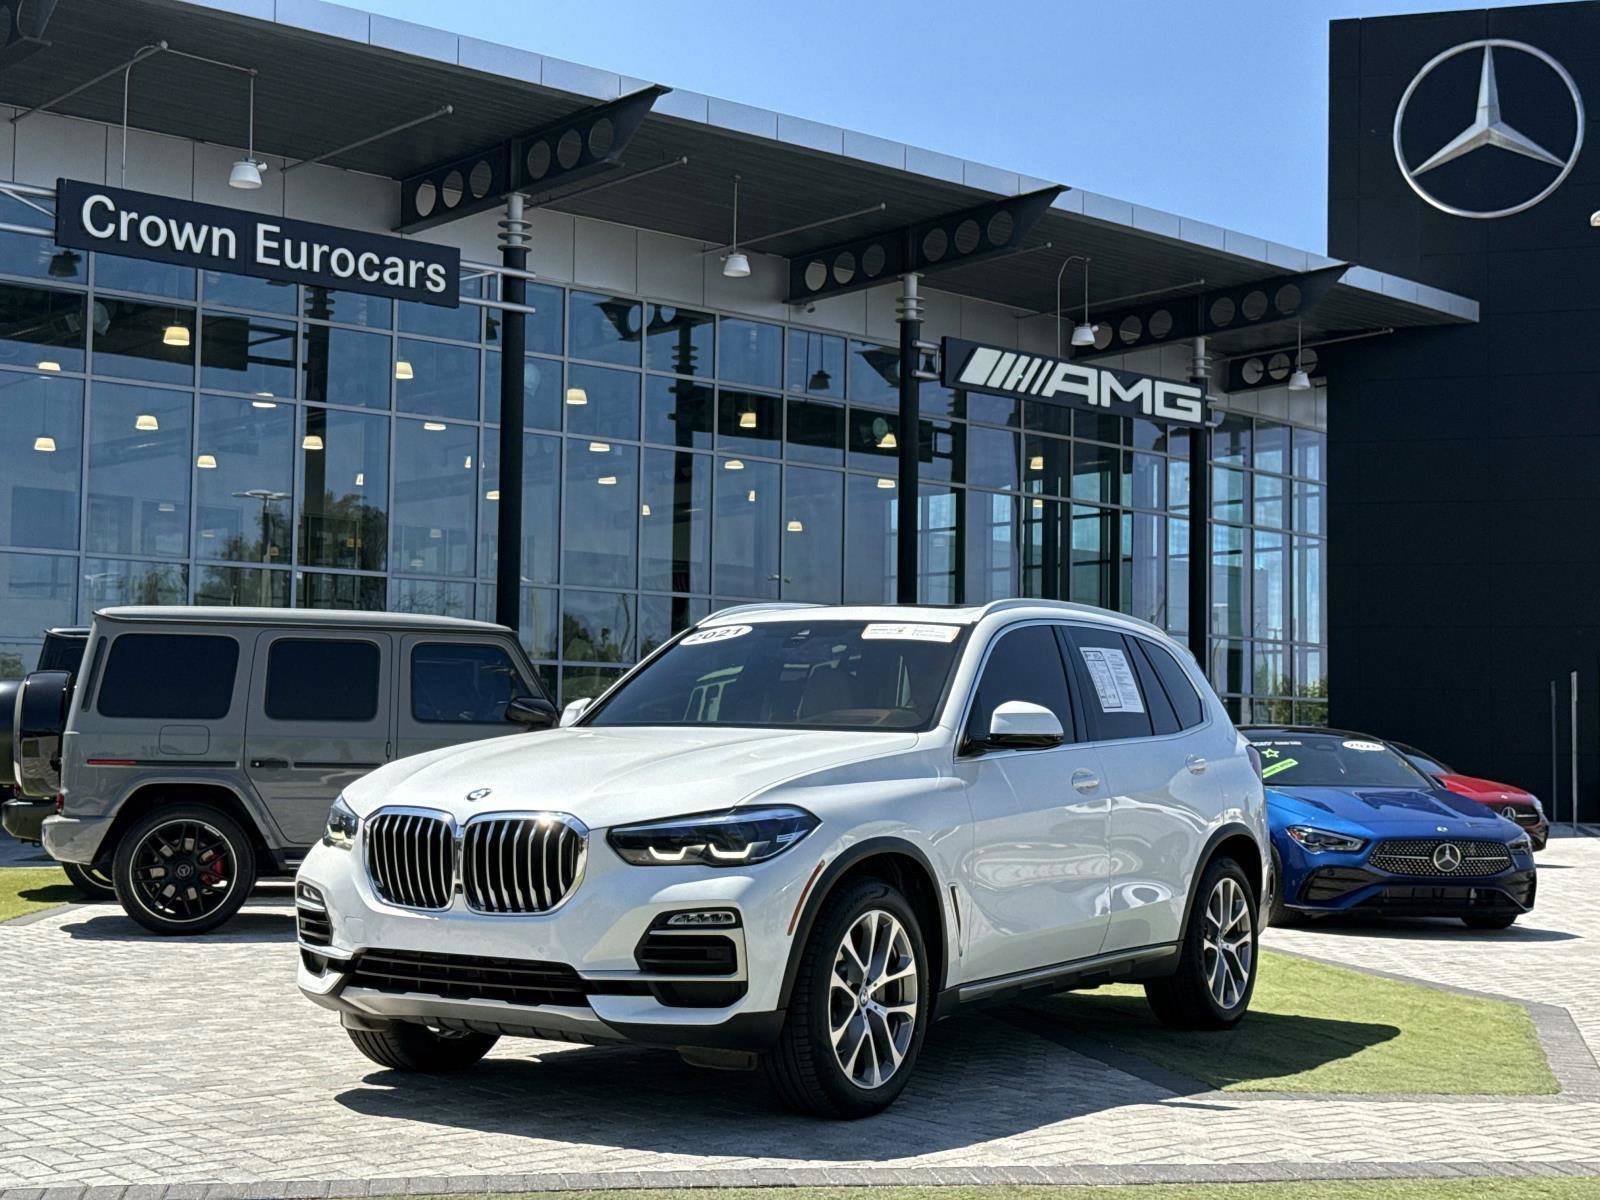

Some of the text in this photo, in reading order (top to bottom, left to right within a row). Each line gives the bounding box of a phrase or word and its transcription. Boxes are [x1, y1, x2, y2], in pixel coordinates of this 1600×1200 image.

[82, 194, 447, 294] Crown Eurocars
[1041, 361, 1202, 423] AMG
[685, 626, 744, 643] 2021
